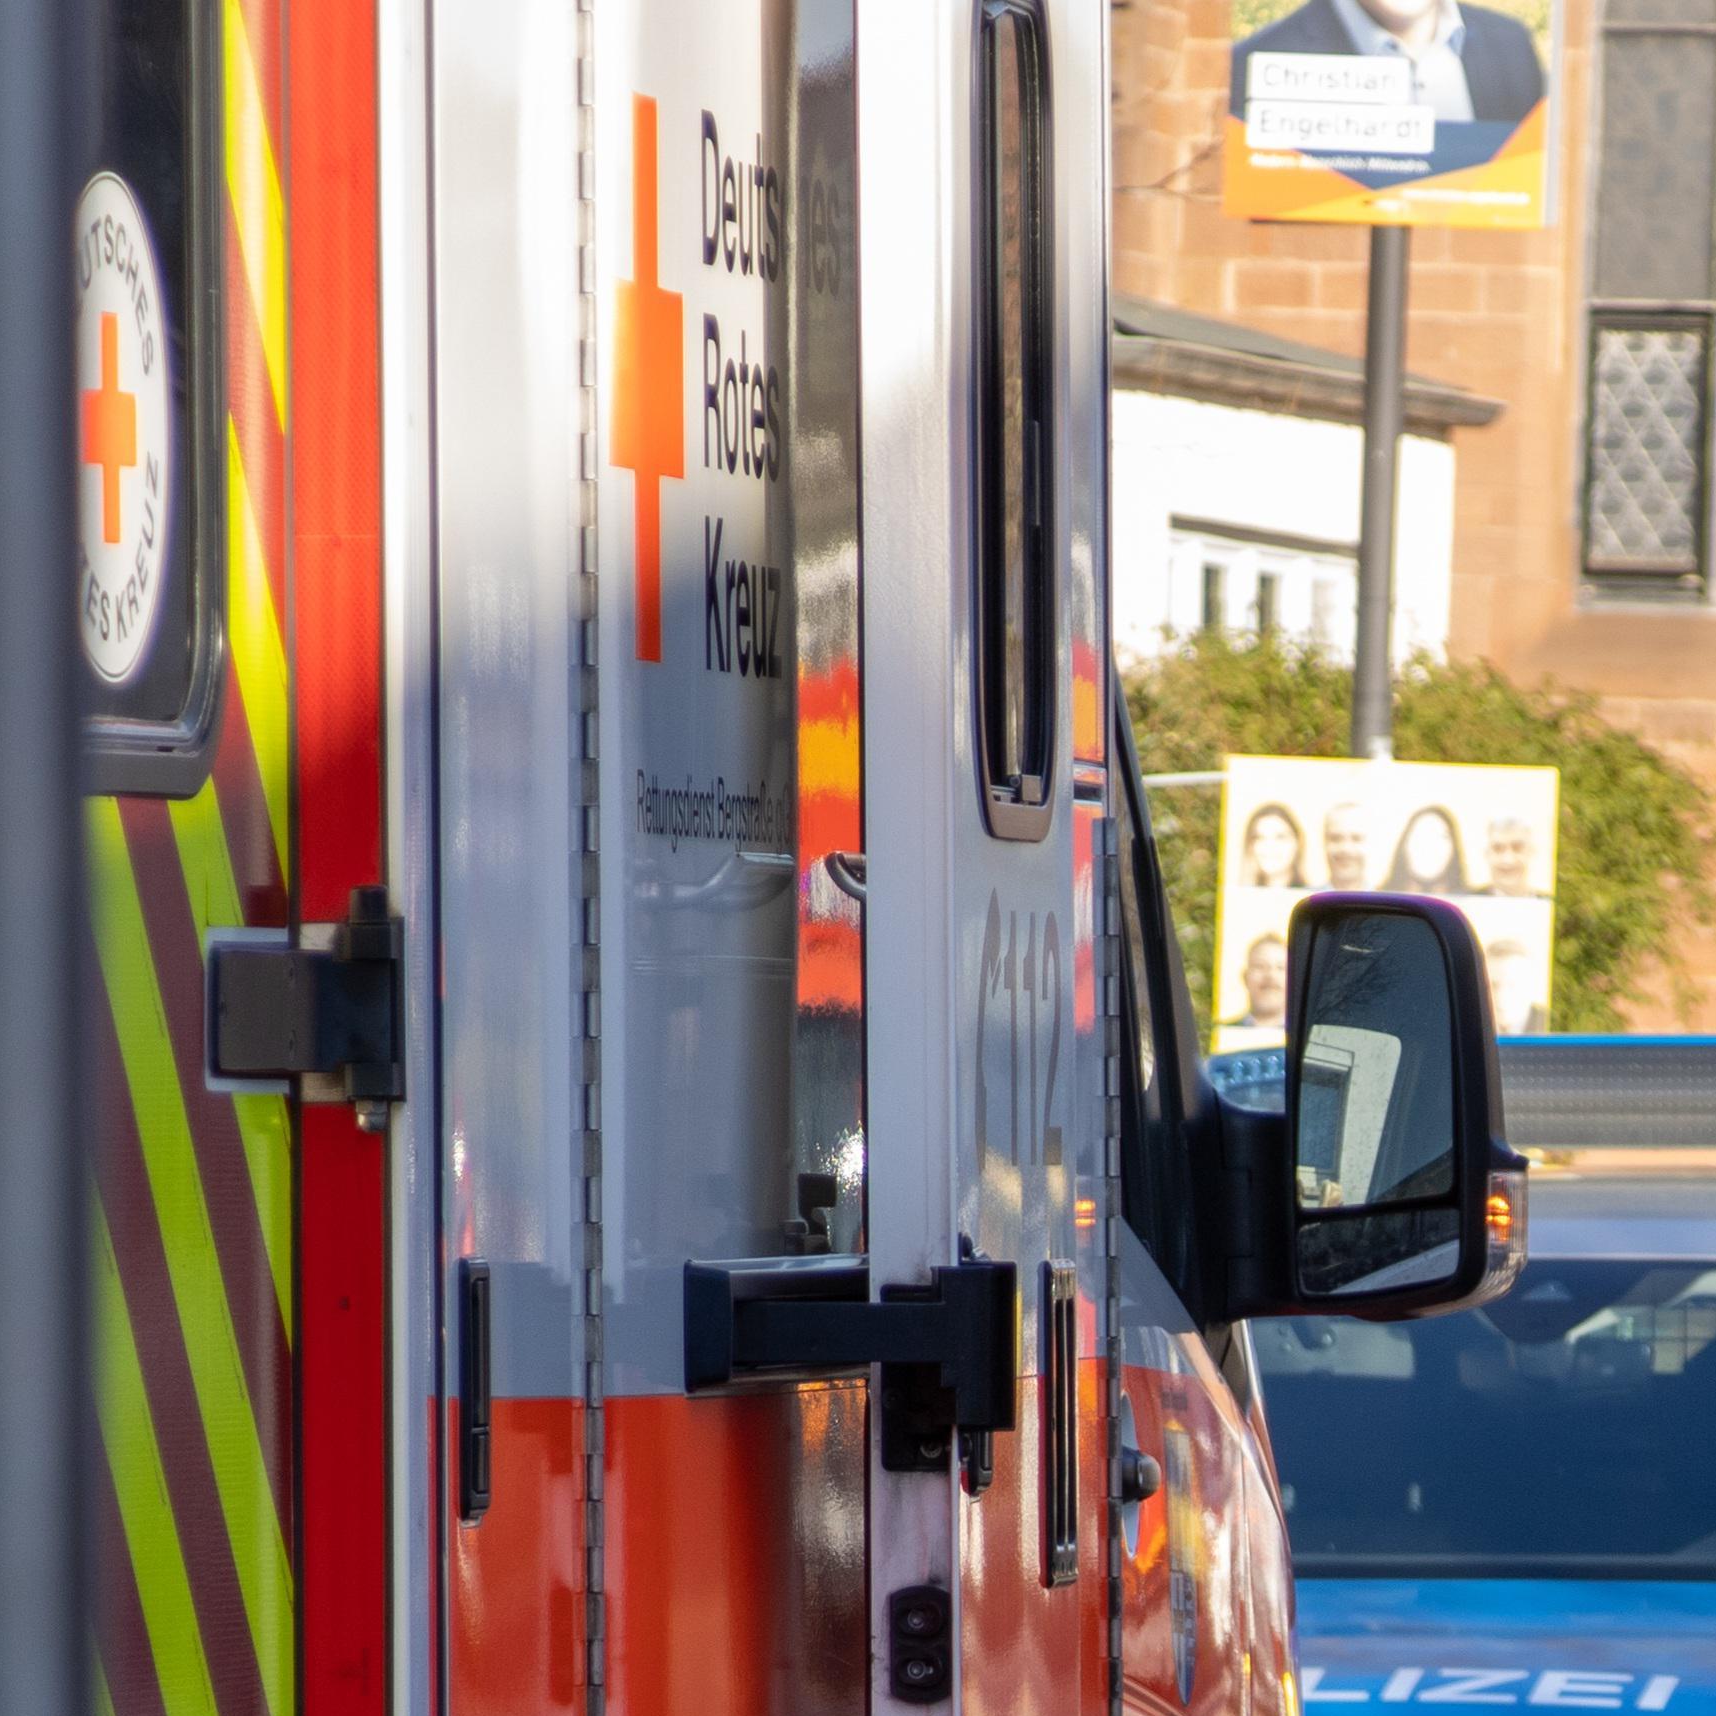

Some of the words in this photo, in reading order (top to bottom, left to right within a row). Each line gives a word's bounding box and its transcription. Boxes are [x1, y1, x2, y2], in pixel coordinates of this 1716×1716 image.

[703, 312, 781, 483] Rotes
[705, 515, 783, 680] Kreuz
[636, 768, 715, 853] Rettungsdienst
[717, 776, 775, 852] Bergstraße
[1004, 910, 1063, 1166] 112
[1301, 1666, 1681, 1712] LIZEI
